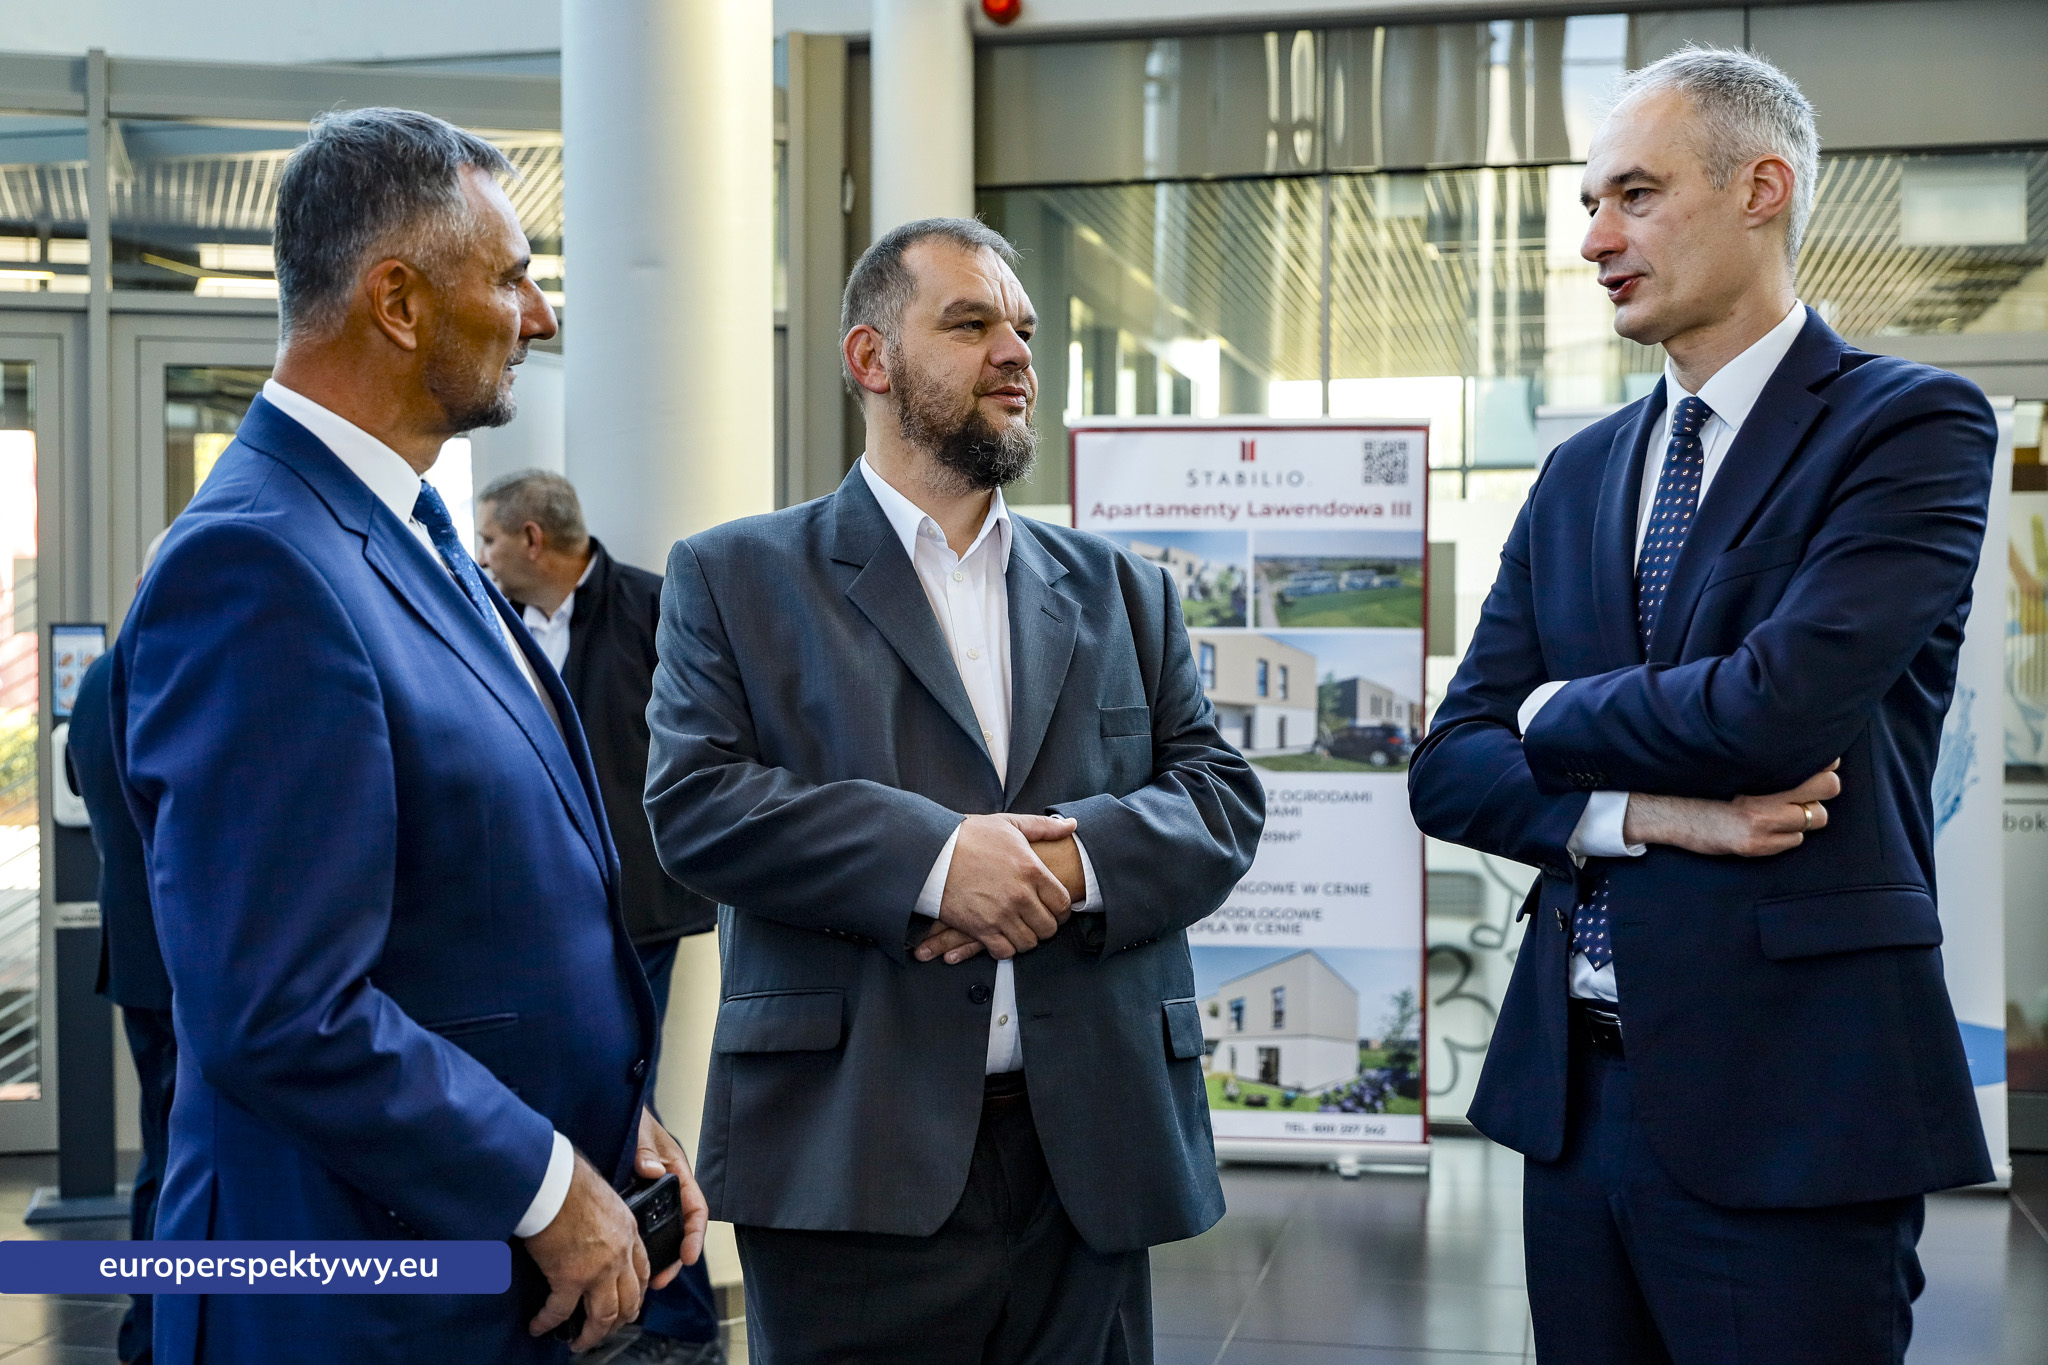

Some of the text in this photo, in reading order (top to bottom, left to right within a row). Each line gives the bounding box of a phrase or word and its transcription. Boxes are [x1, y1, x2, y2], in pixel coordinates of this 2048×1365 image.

[1186, 470, 1304, 487] STABILIO
[1091, 500, 1412, 520] Apartamenty Lawendowa III
[1280, 790, 1372, 802] OGRODAMI
[1302, 883, 1319, 894] W
[1323, 882, 1371, 895] CENIE
[1234, 922, 1250, 934] W
[1254, 922, 1303, 935] CENIE
